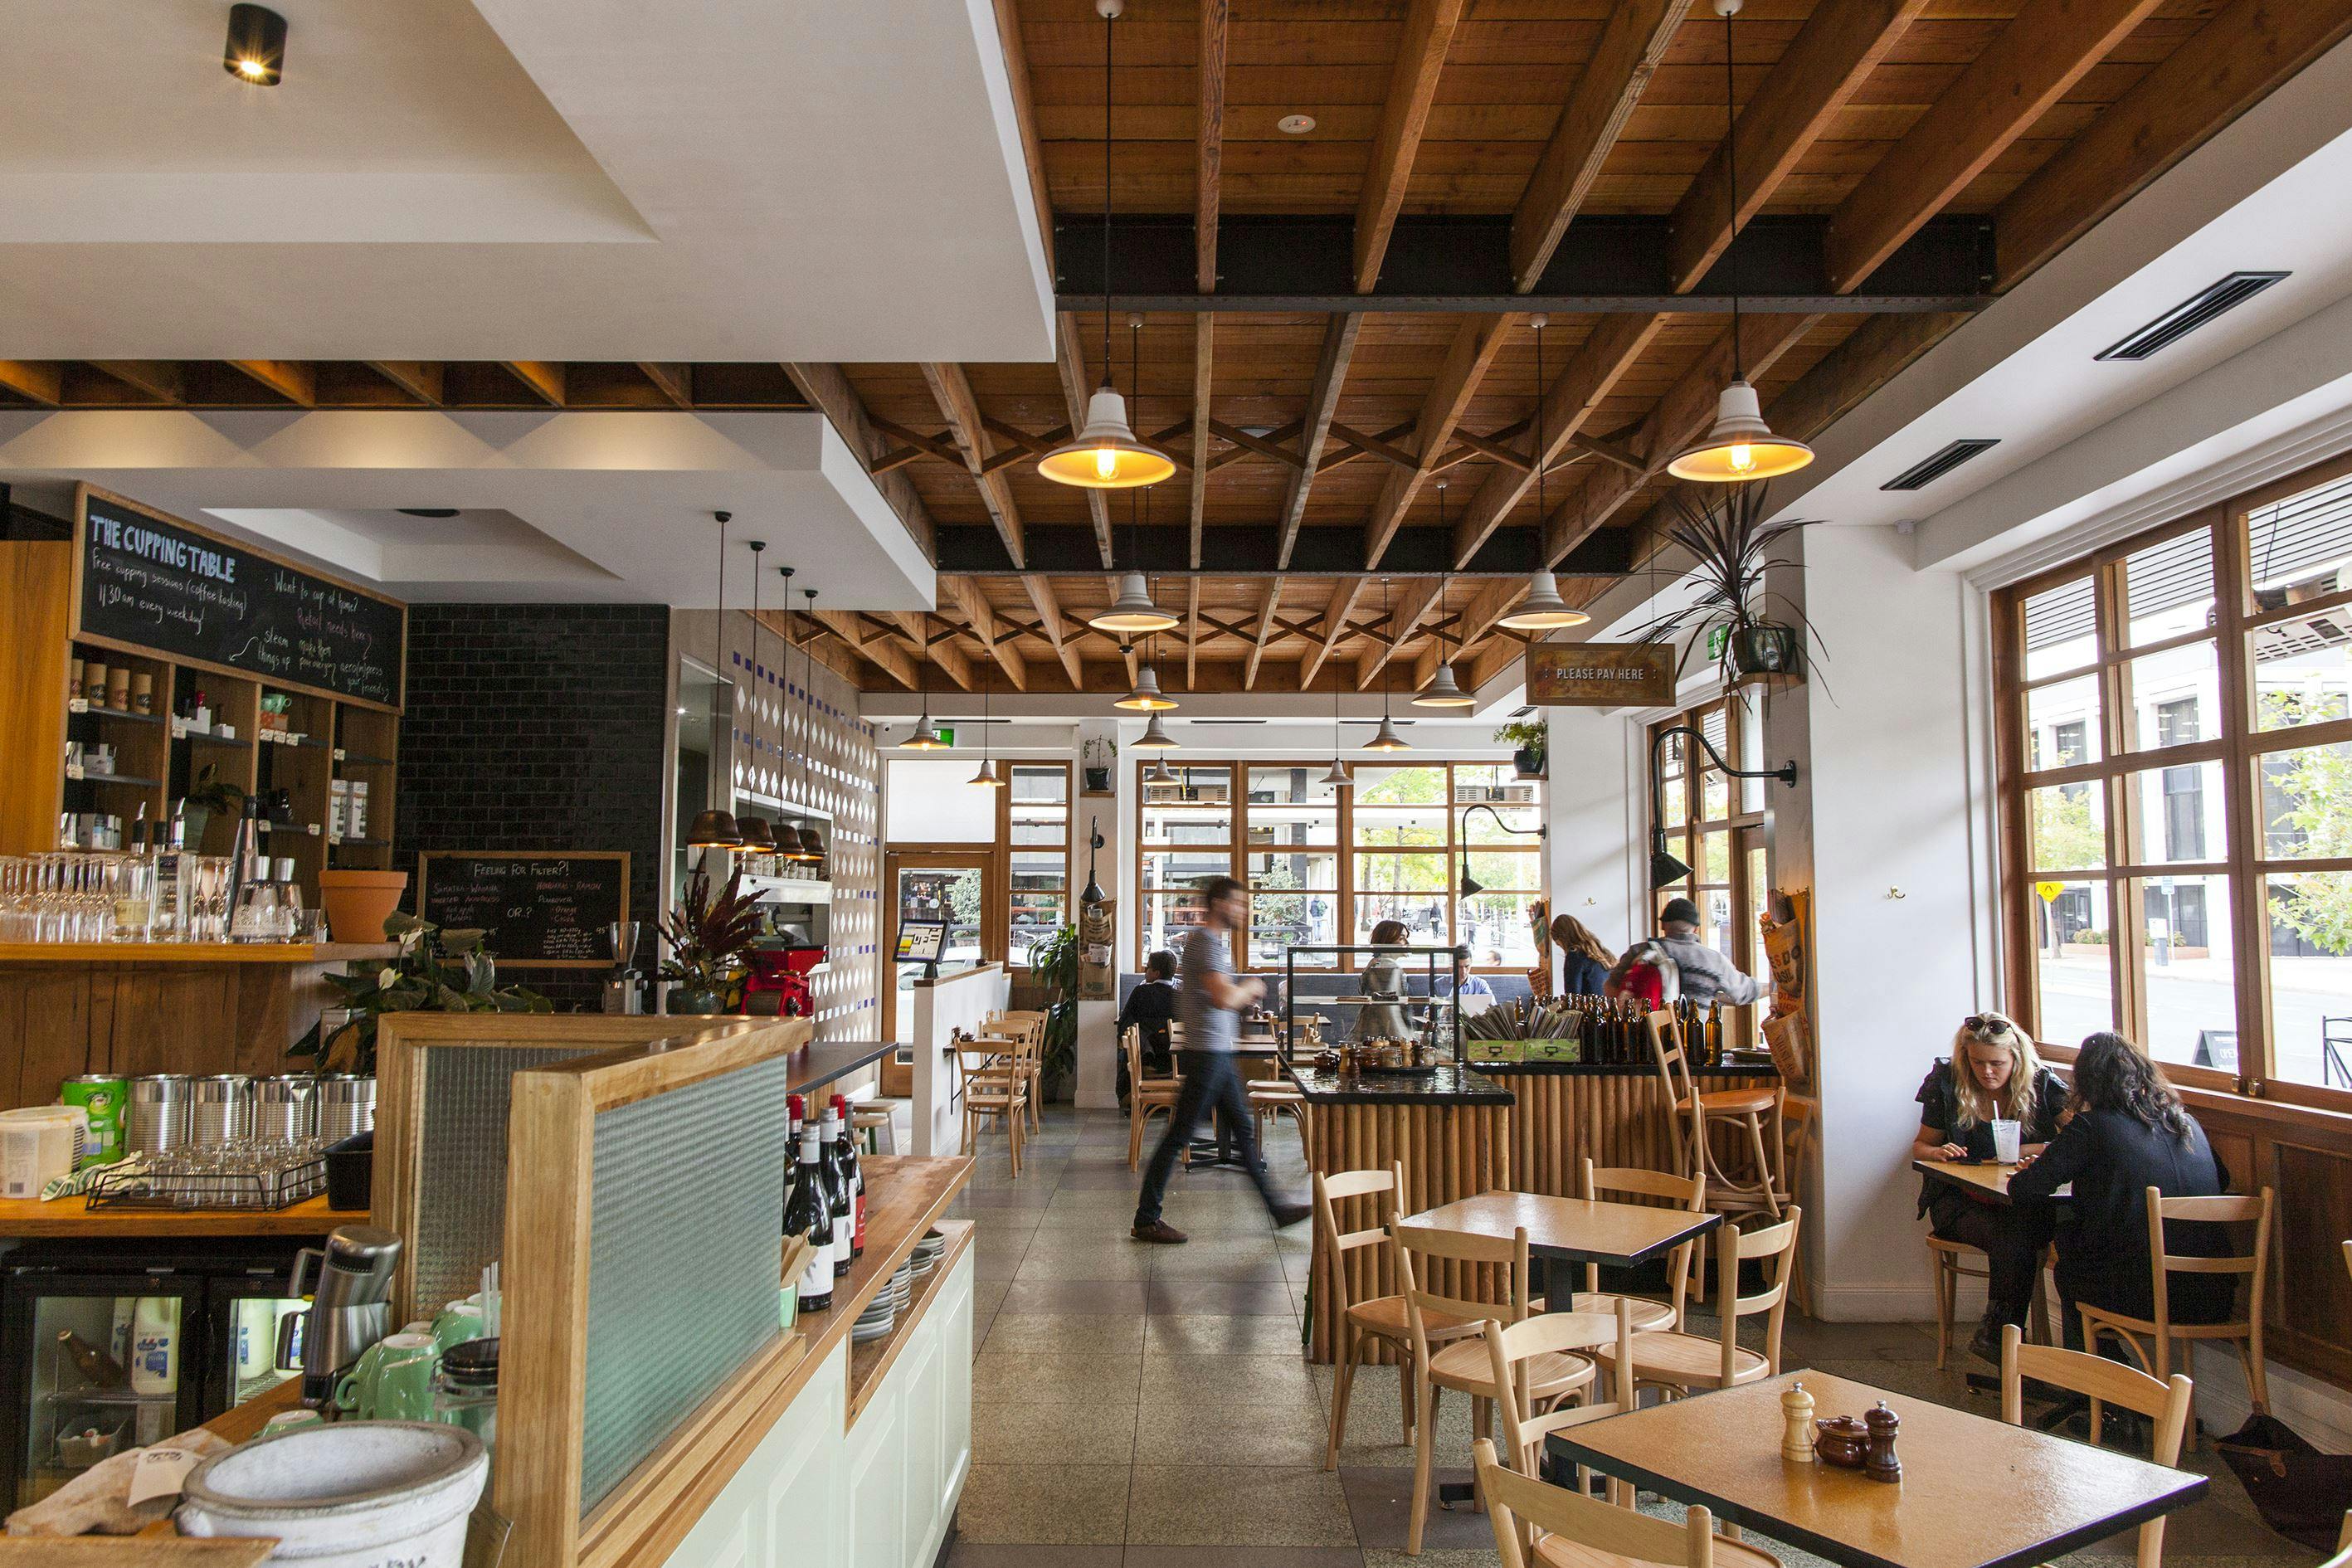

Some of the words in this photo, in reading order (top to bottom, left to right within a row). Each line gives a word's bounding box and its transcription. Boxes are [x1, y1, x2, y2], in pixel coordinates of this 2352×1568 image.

[90, 514, 121, 549] THE
[124, 525, 187, 567] CUPPING
[187, 546, 236, 584] TABLE
[92, 547, 111, 570] Free
[115, 565, 147, 588] cupping
[139, 598, 163, 625] every
[1556, 668, 1594, 679] PLEASE
[1597, 668, 1617, 679] PAY
[1619, 669, 1644, 680] HERE
[474, 863, 507, 877] FEELING
[511, 863, 527, 877] FOR
